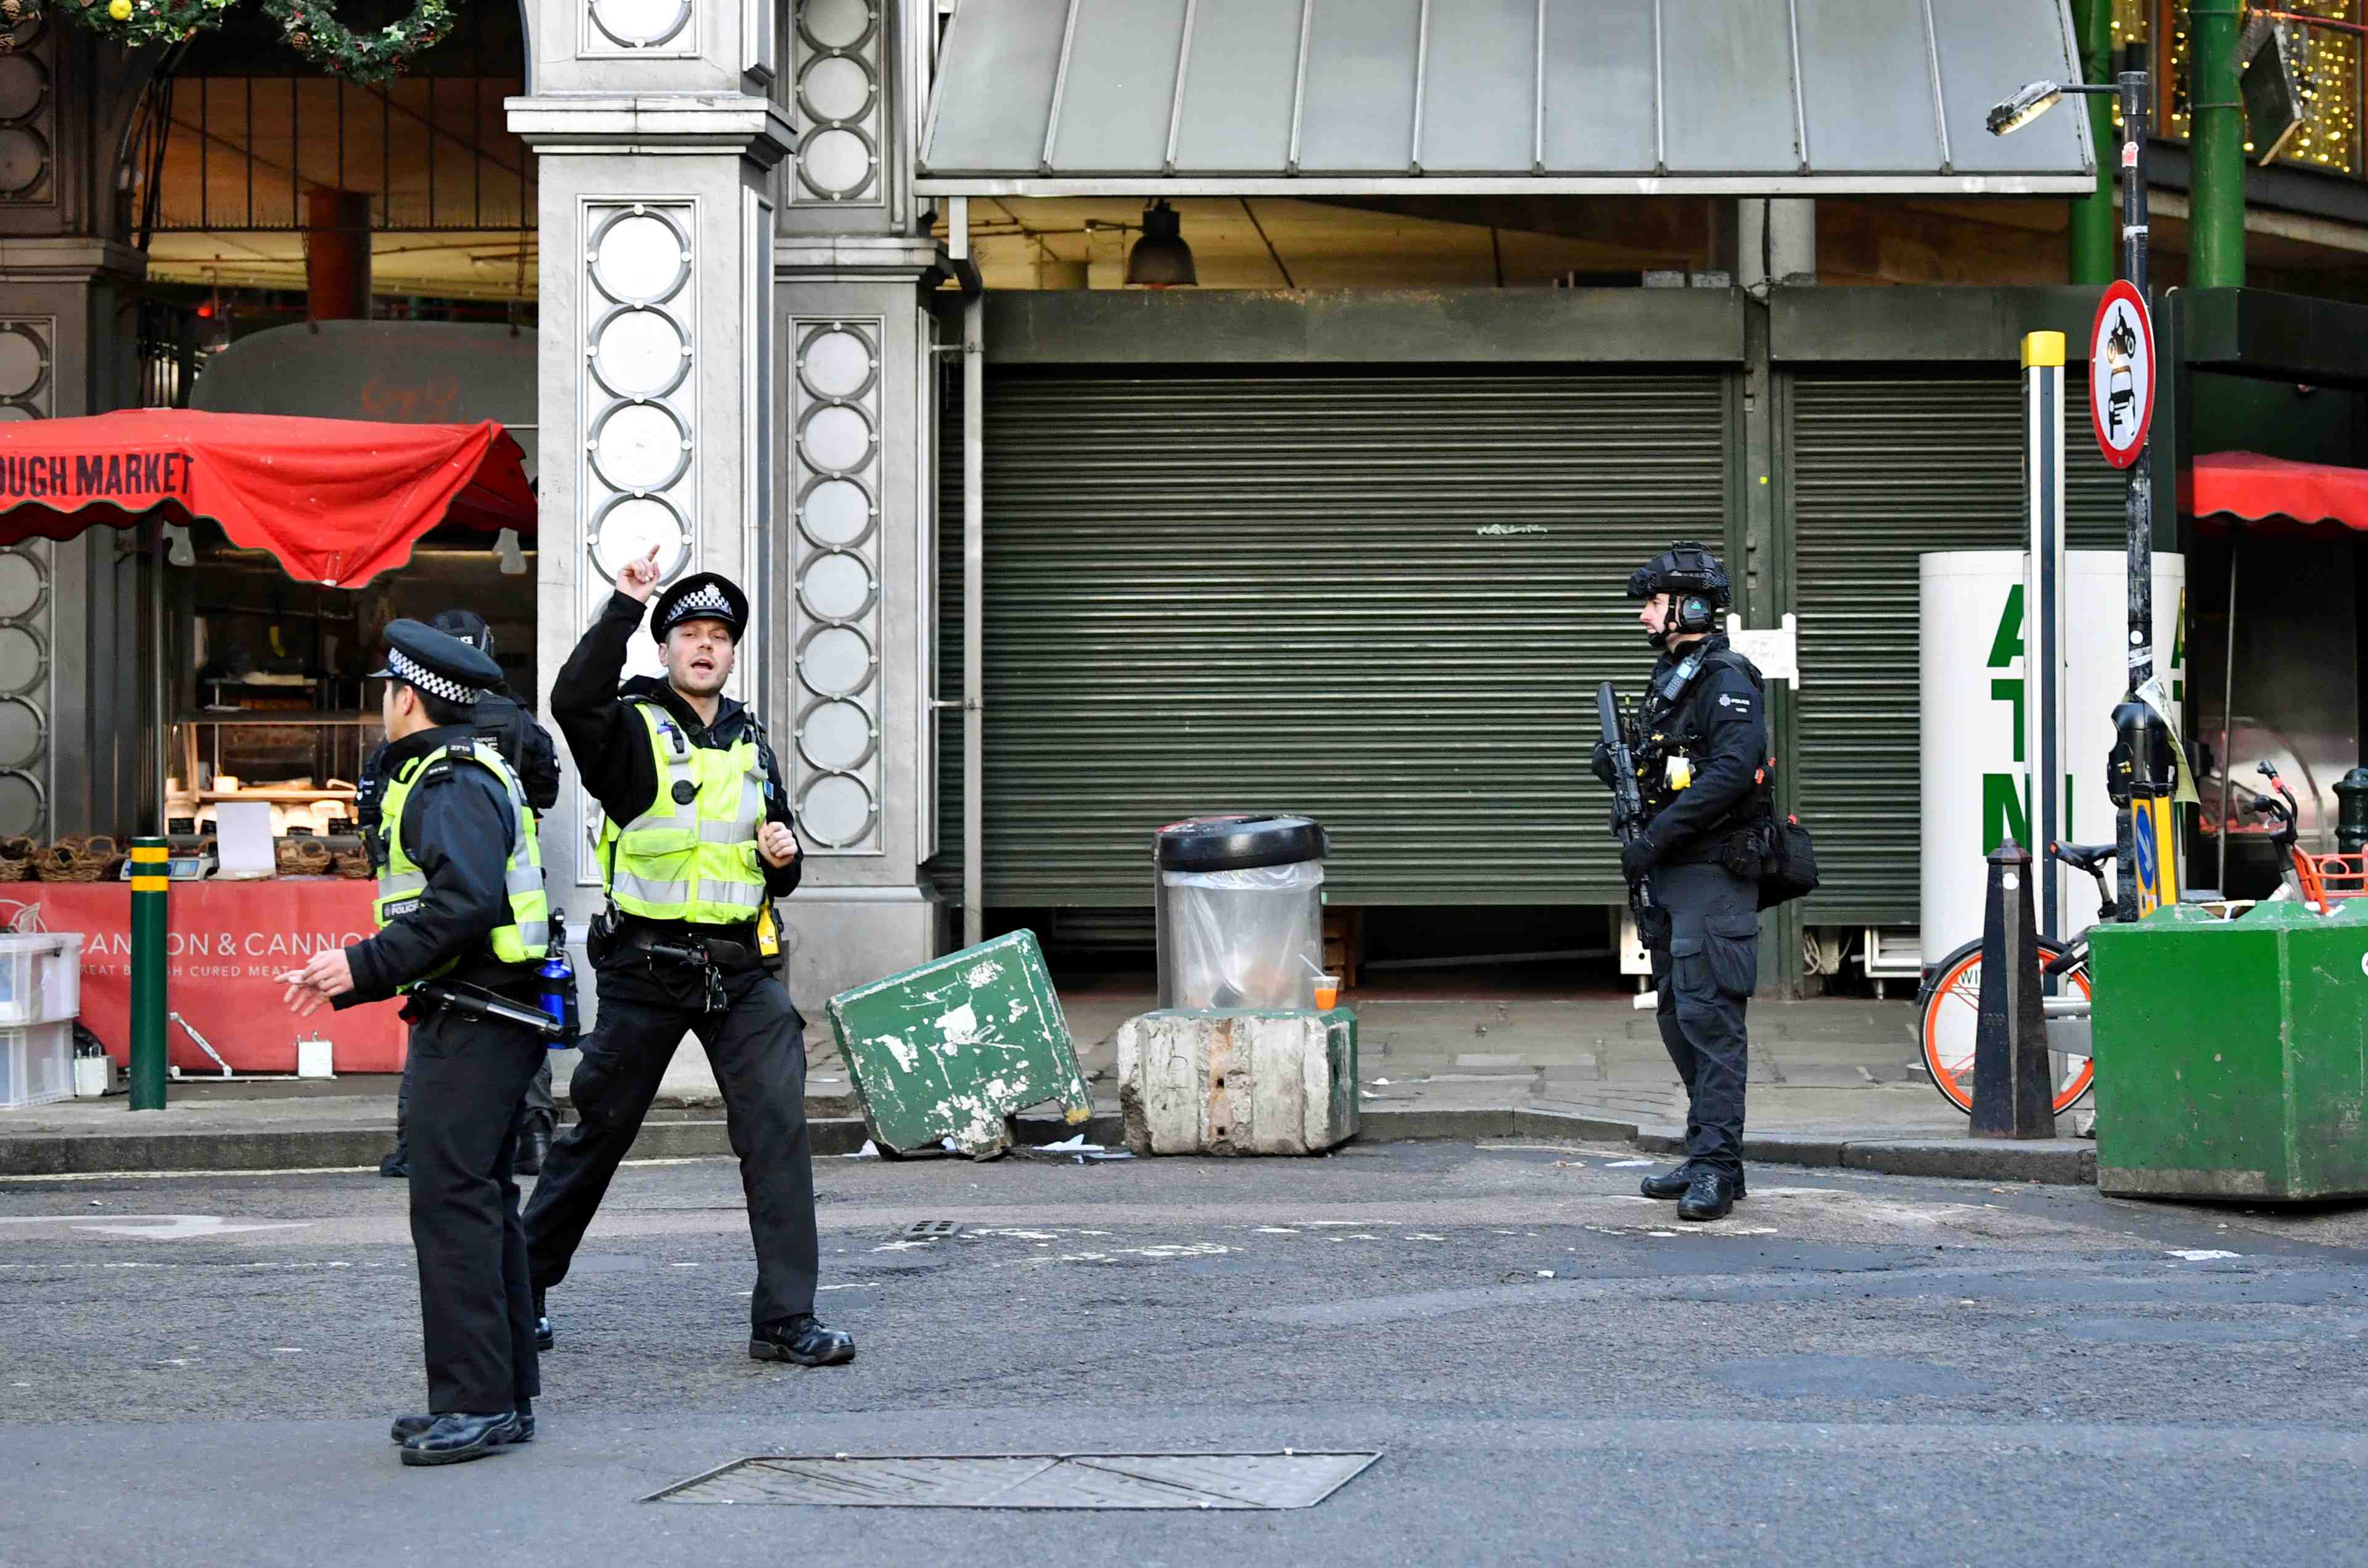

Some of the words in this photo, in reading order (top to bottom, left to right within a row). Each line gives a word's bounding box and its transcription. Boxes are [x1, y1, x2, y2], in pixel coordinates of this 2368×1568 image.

[76, 453, 194, 496] MARKET
[80, 932, 208, 956] ANON
[217, 932, 237, 956] &
[245, 932, 378, 956] CANNO
[81, 964, 116, 976] REAT
[189, 966, 241, 977] CURED
